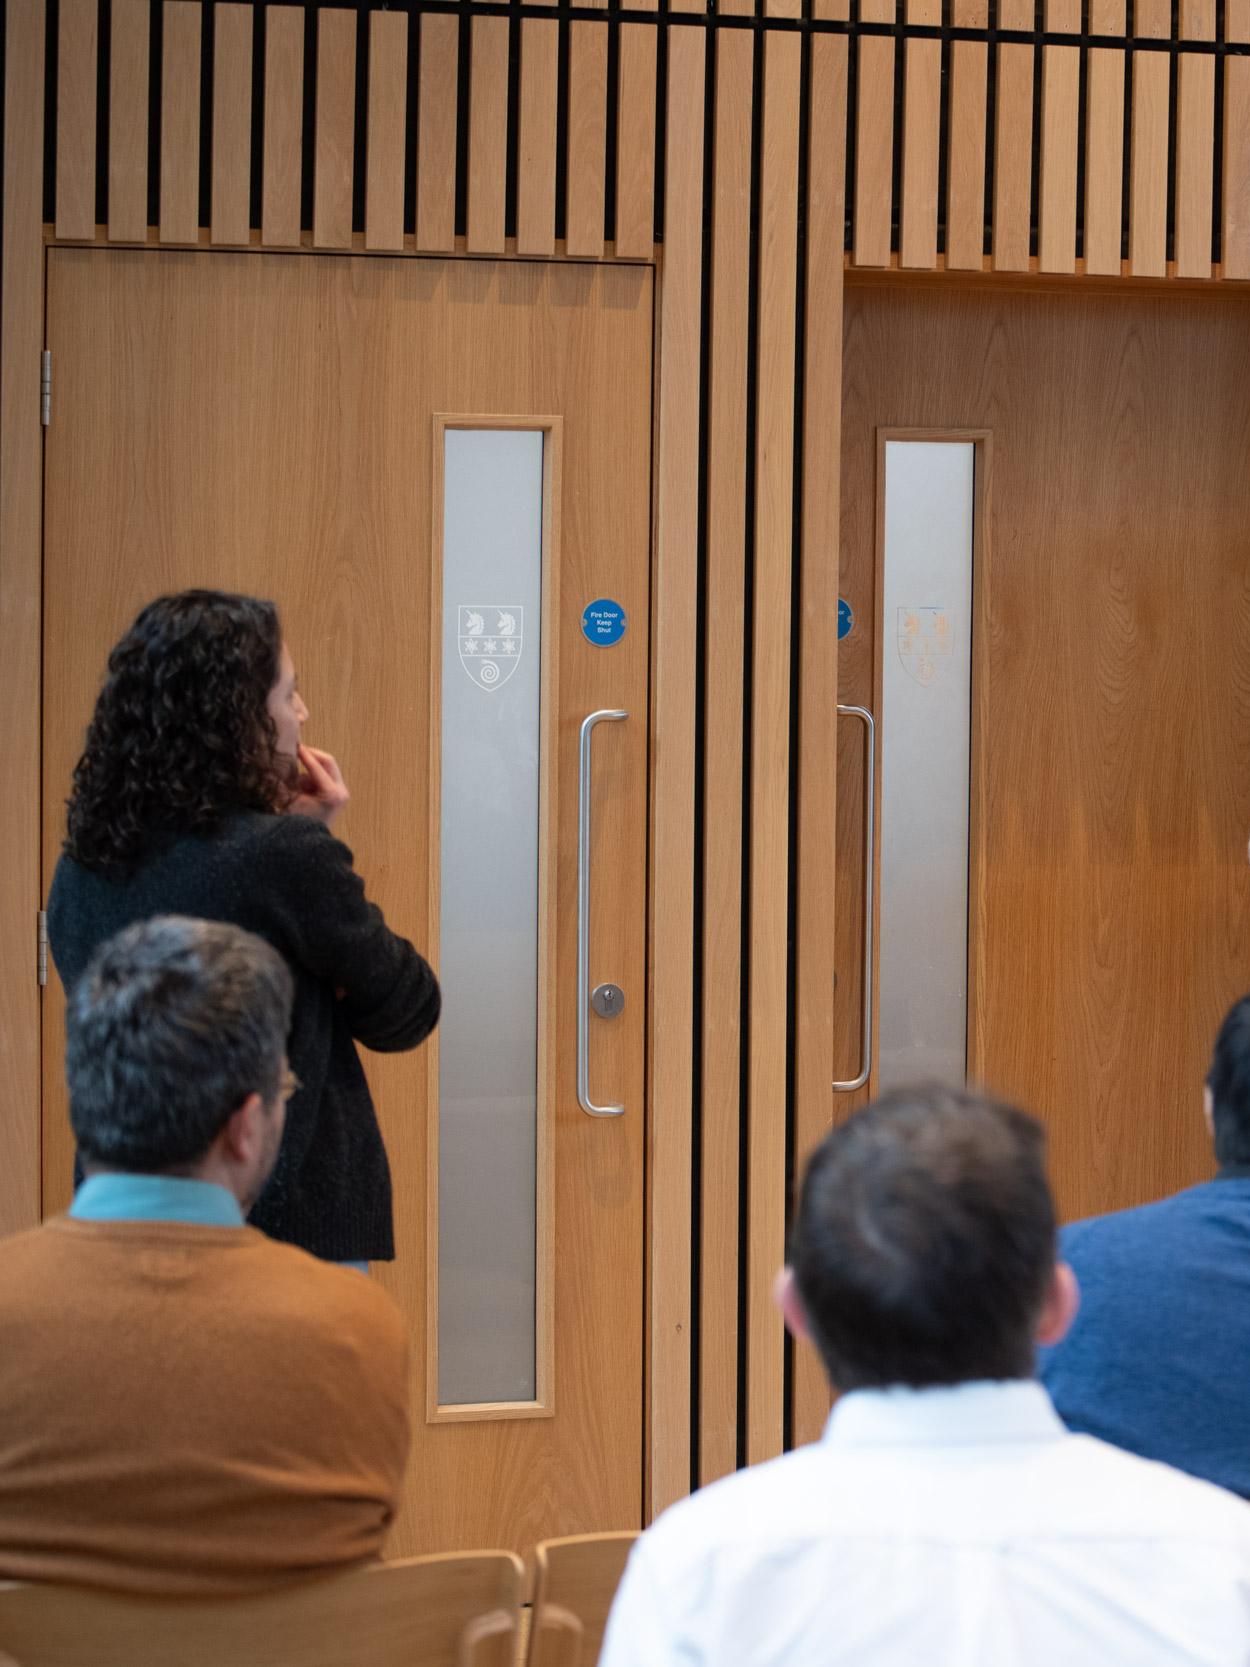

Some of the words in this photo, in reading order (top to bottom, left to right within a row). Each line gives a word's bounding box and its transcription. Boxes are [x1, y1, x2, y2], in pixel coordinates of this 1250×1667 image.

[590, 611, 602, 619] Fire
[603, 611, 618, 619] Door
[596, 619, 612, 627] Keep
